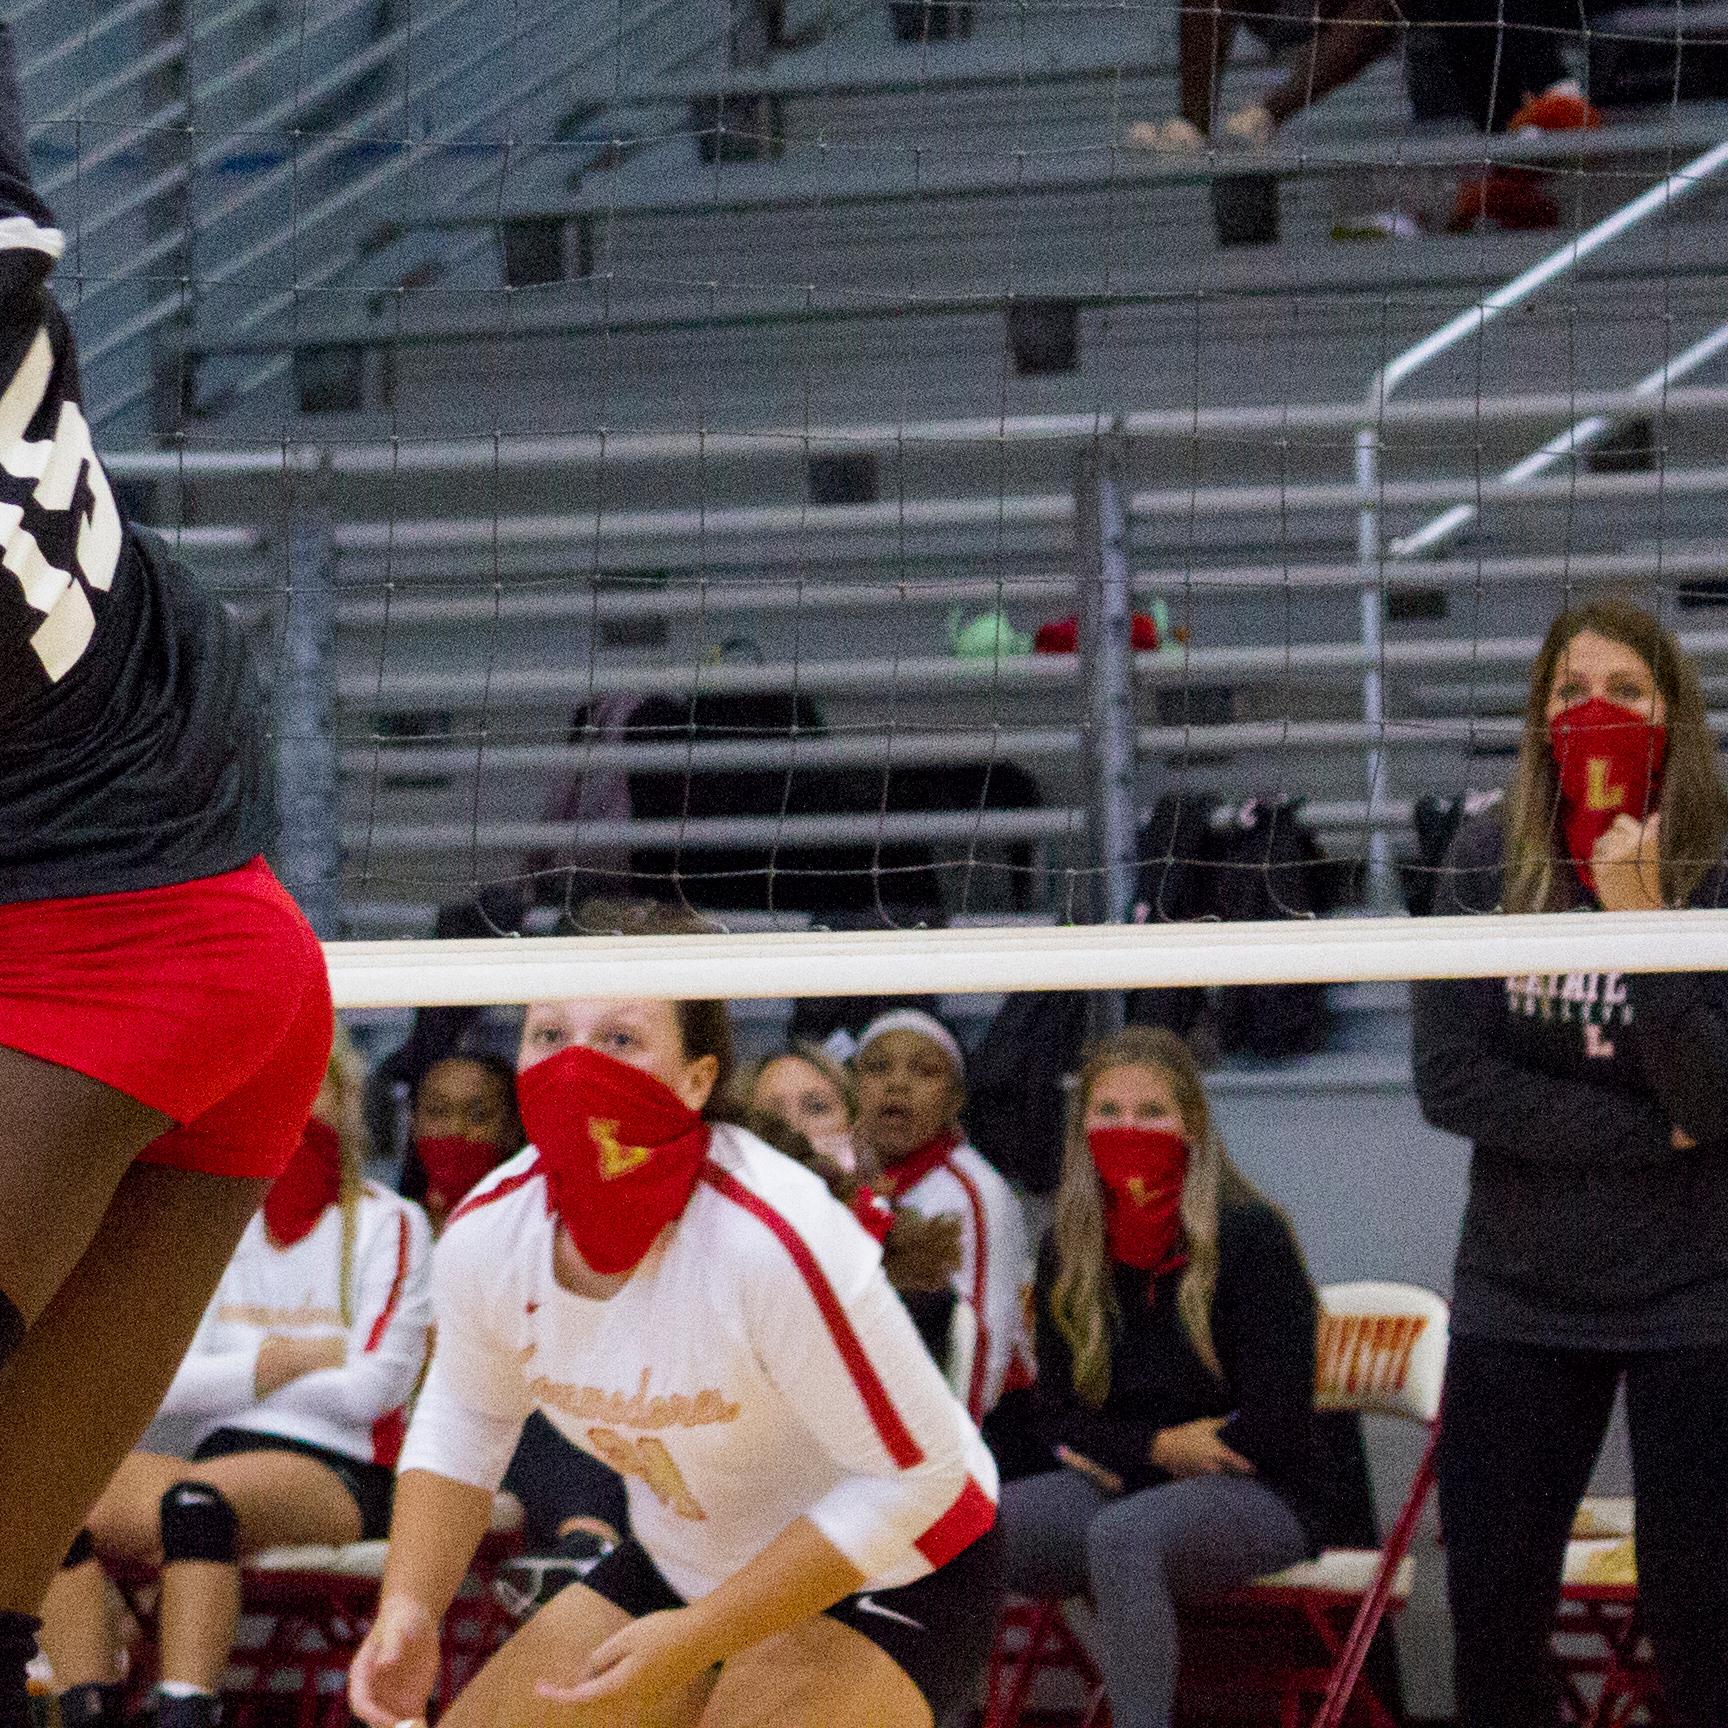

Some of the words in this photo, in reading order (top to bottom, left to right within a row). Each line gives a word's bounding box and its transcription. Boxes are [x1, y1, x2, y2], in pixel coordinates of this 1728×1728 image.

[1586, 757, 1625, 810] L
[1585, 1024, 1615, 1059] L
[587, 1117, 654, 1182] L
